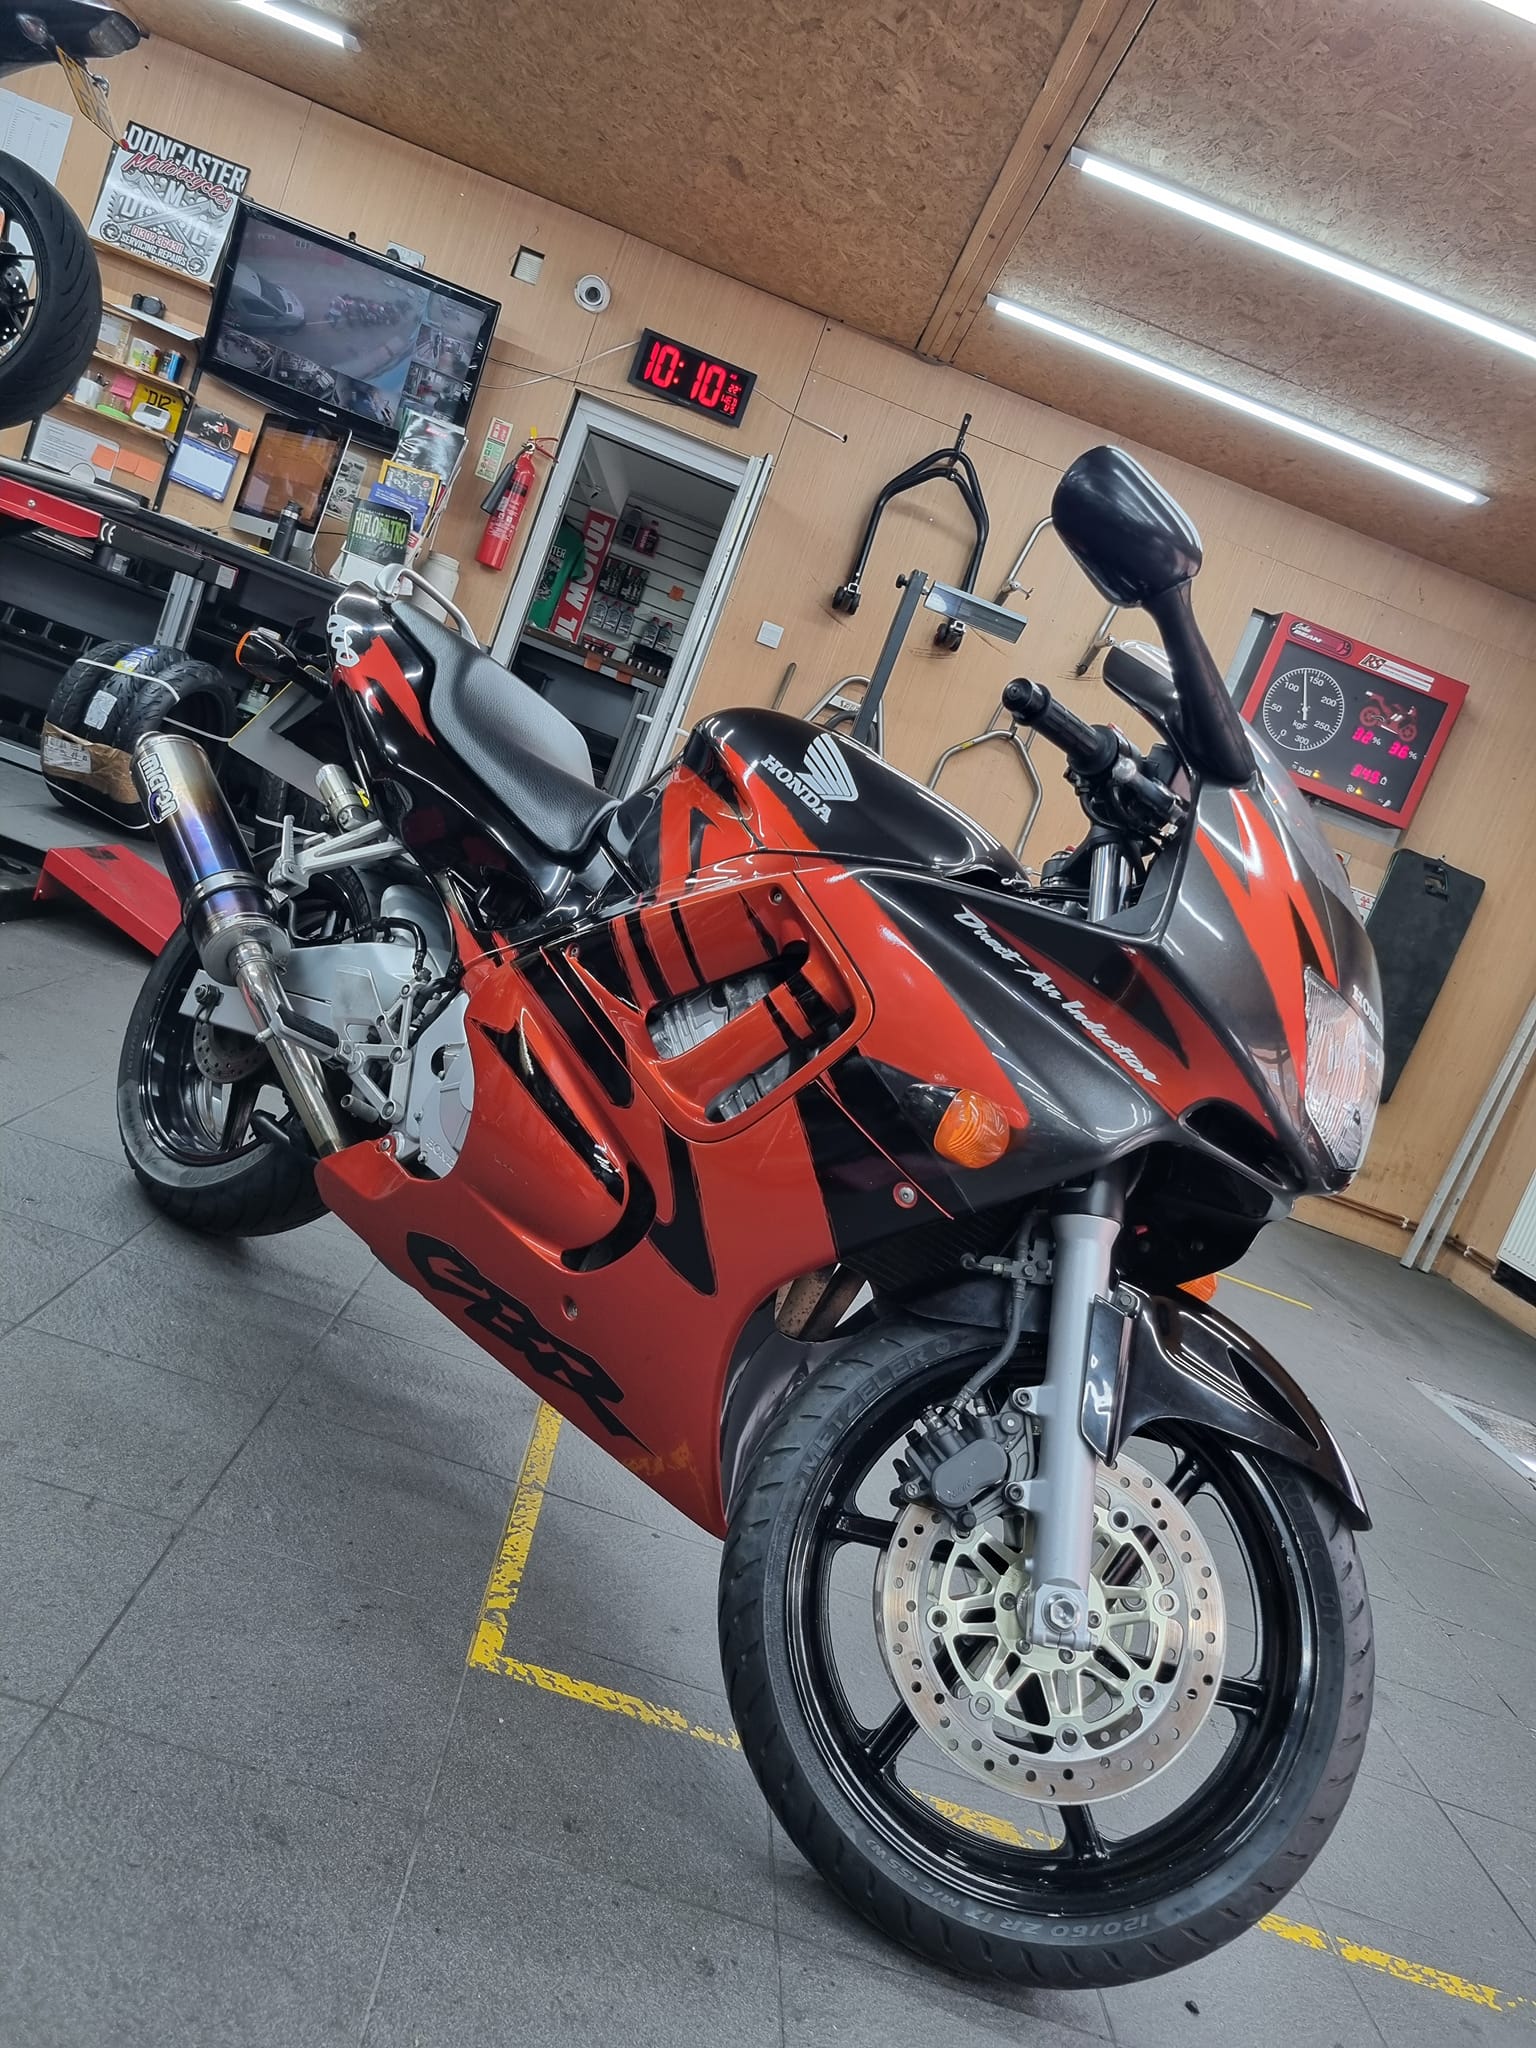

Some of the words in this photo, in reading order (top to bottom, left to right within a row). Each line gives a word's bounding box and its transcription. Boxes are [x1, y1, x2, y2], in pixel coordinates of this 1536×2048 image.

[126, 124, 250, 193] DONCASTER
[121, 152, 234, 212] Motorcycles
[131, 225, 157, 245] 01302
[352, 511, 407, 545] HIFLOFILTRO
[1284, 682, 1300, 693] 100
[1308, 675, 1324, 687] 150
[1271, 703, 1282, 713] 50
[1320, 695, 1337, 707] 200
[1279, 728, 1288, 737] 0
[1313, 719, 1331, 732] 250
[1294, 734, 1310, 746] 300
[761, 754, 834, 825] HONDA
[954, 904, 1029, 967] Direct
[1014, 968, 1062, 1000] Air
[1061, 1000, 1162, 1086] Induction
[406, 1231, 655, 1456] CBR
[800, 1348, 928, 1481] METZELER
[1000, 1916, 1043, 1936] ZR
[1051, 1914, 1150, 1938] 120/60
